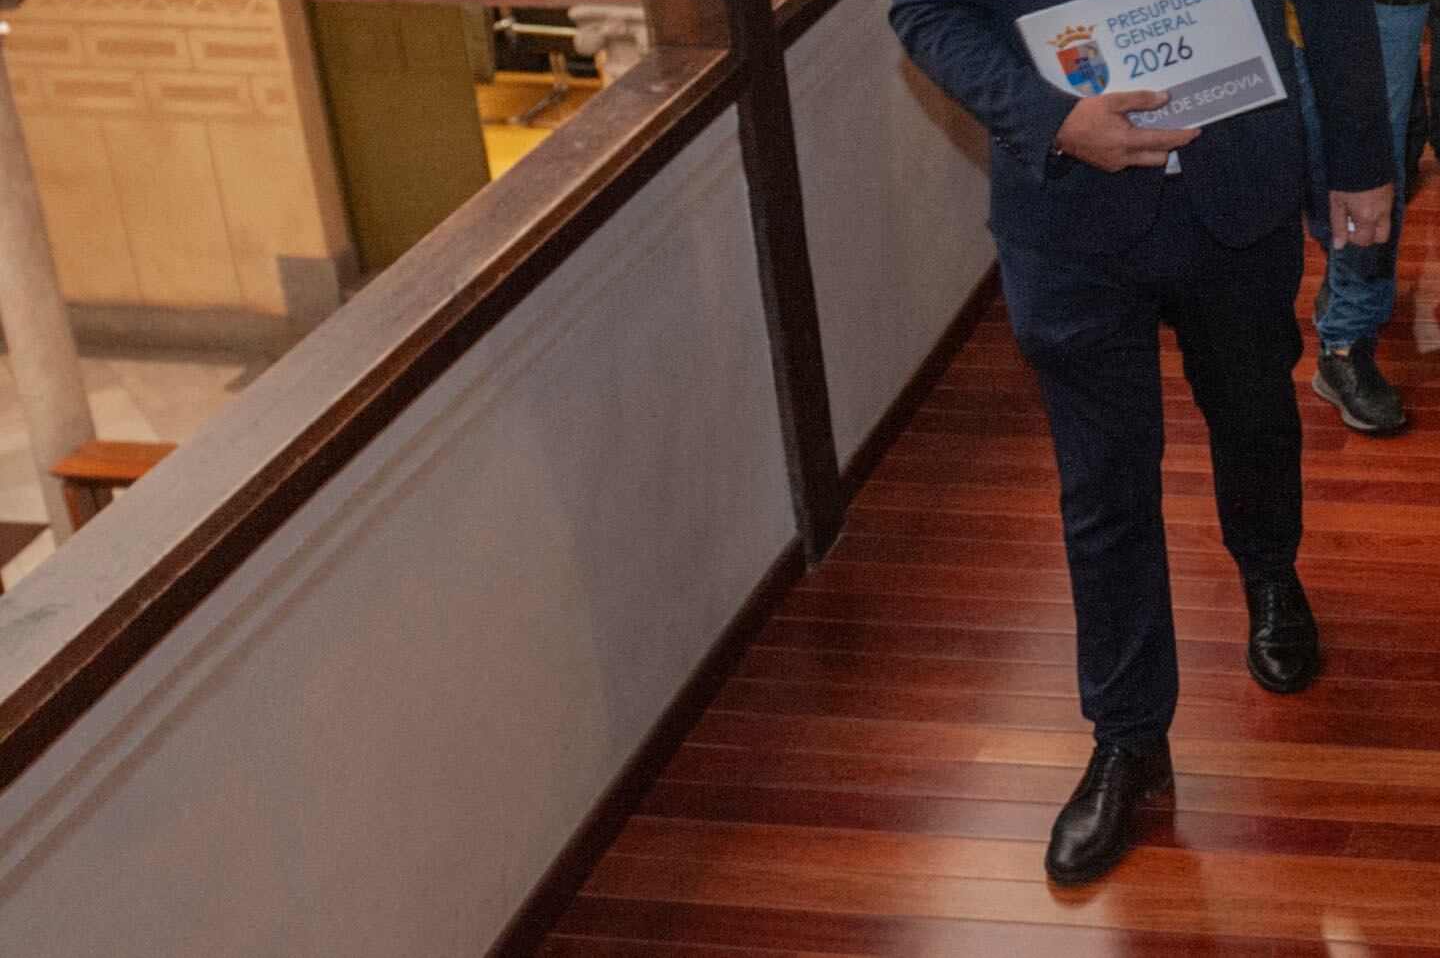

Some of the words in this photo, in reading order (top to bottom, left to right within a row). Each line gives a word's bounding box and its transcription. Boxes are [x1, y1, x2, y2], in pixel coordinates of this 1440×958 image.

[1114, 12, 1198, 49] GENERAL
[1123, 36, 1194, 79] 2026
[1171, 95, 1193, 116] DE
[1194, 73, 1264, 107] SEGOVIA
